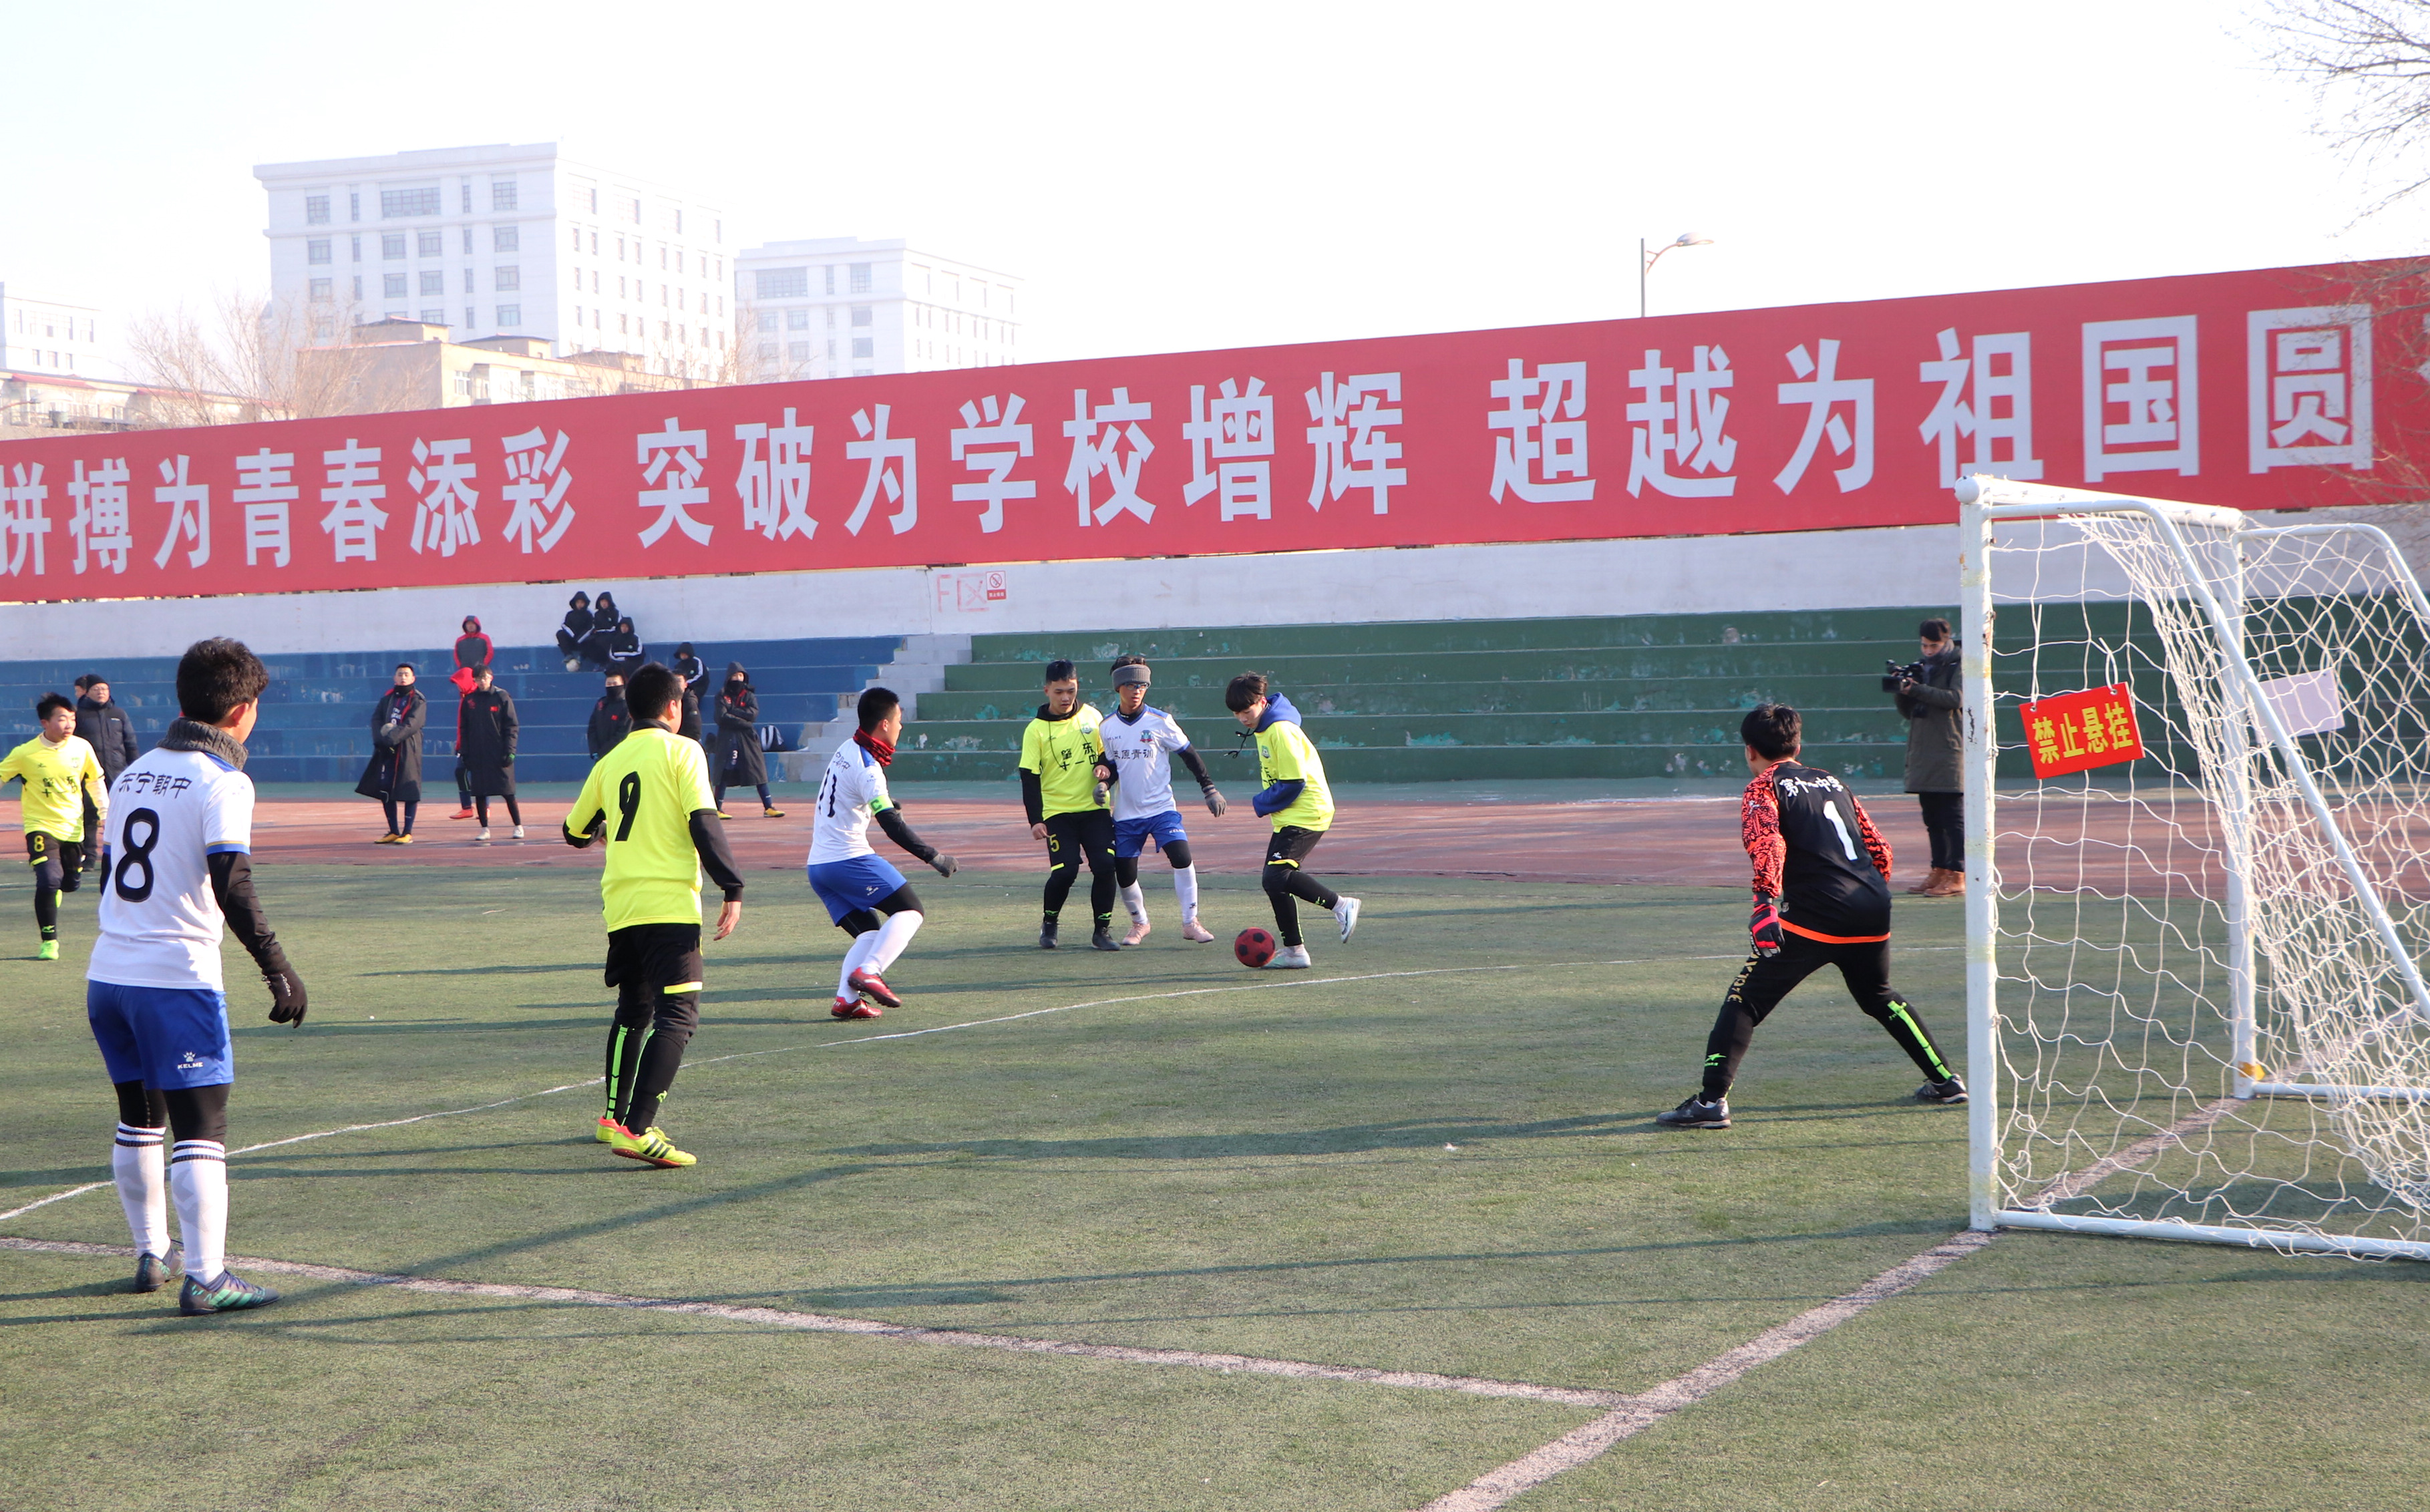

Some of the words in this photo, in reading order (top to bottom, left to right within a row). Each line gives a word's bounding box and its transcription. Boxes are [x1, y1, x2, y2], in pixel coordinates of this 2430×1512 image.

[0, 425, 576, 576] 拼搏为青春添彩
[637, 372, 1407, 548] 突破为学校增辉
[1488, 304, 2430, 504] 超越为祖国圆
[732, 750, 738, 759] 3
[2031, 701, 2134, 764] 禁止悬挂
[615, 771, 641, 841] 9
[870, 799, 882, 812] C
[1824, 800, 1858, 861] 1
[34, 835, 45, 852] 8
[115, 807, 160, 902] 8
[1049, 833, 1060, 852] 5
